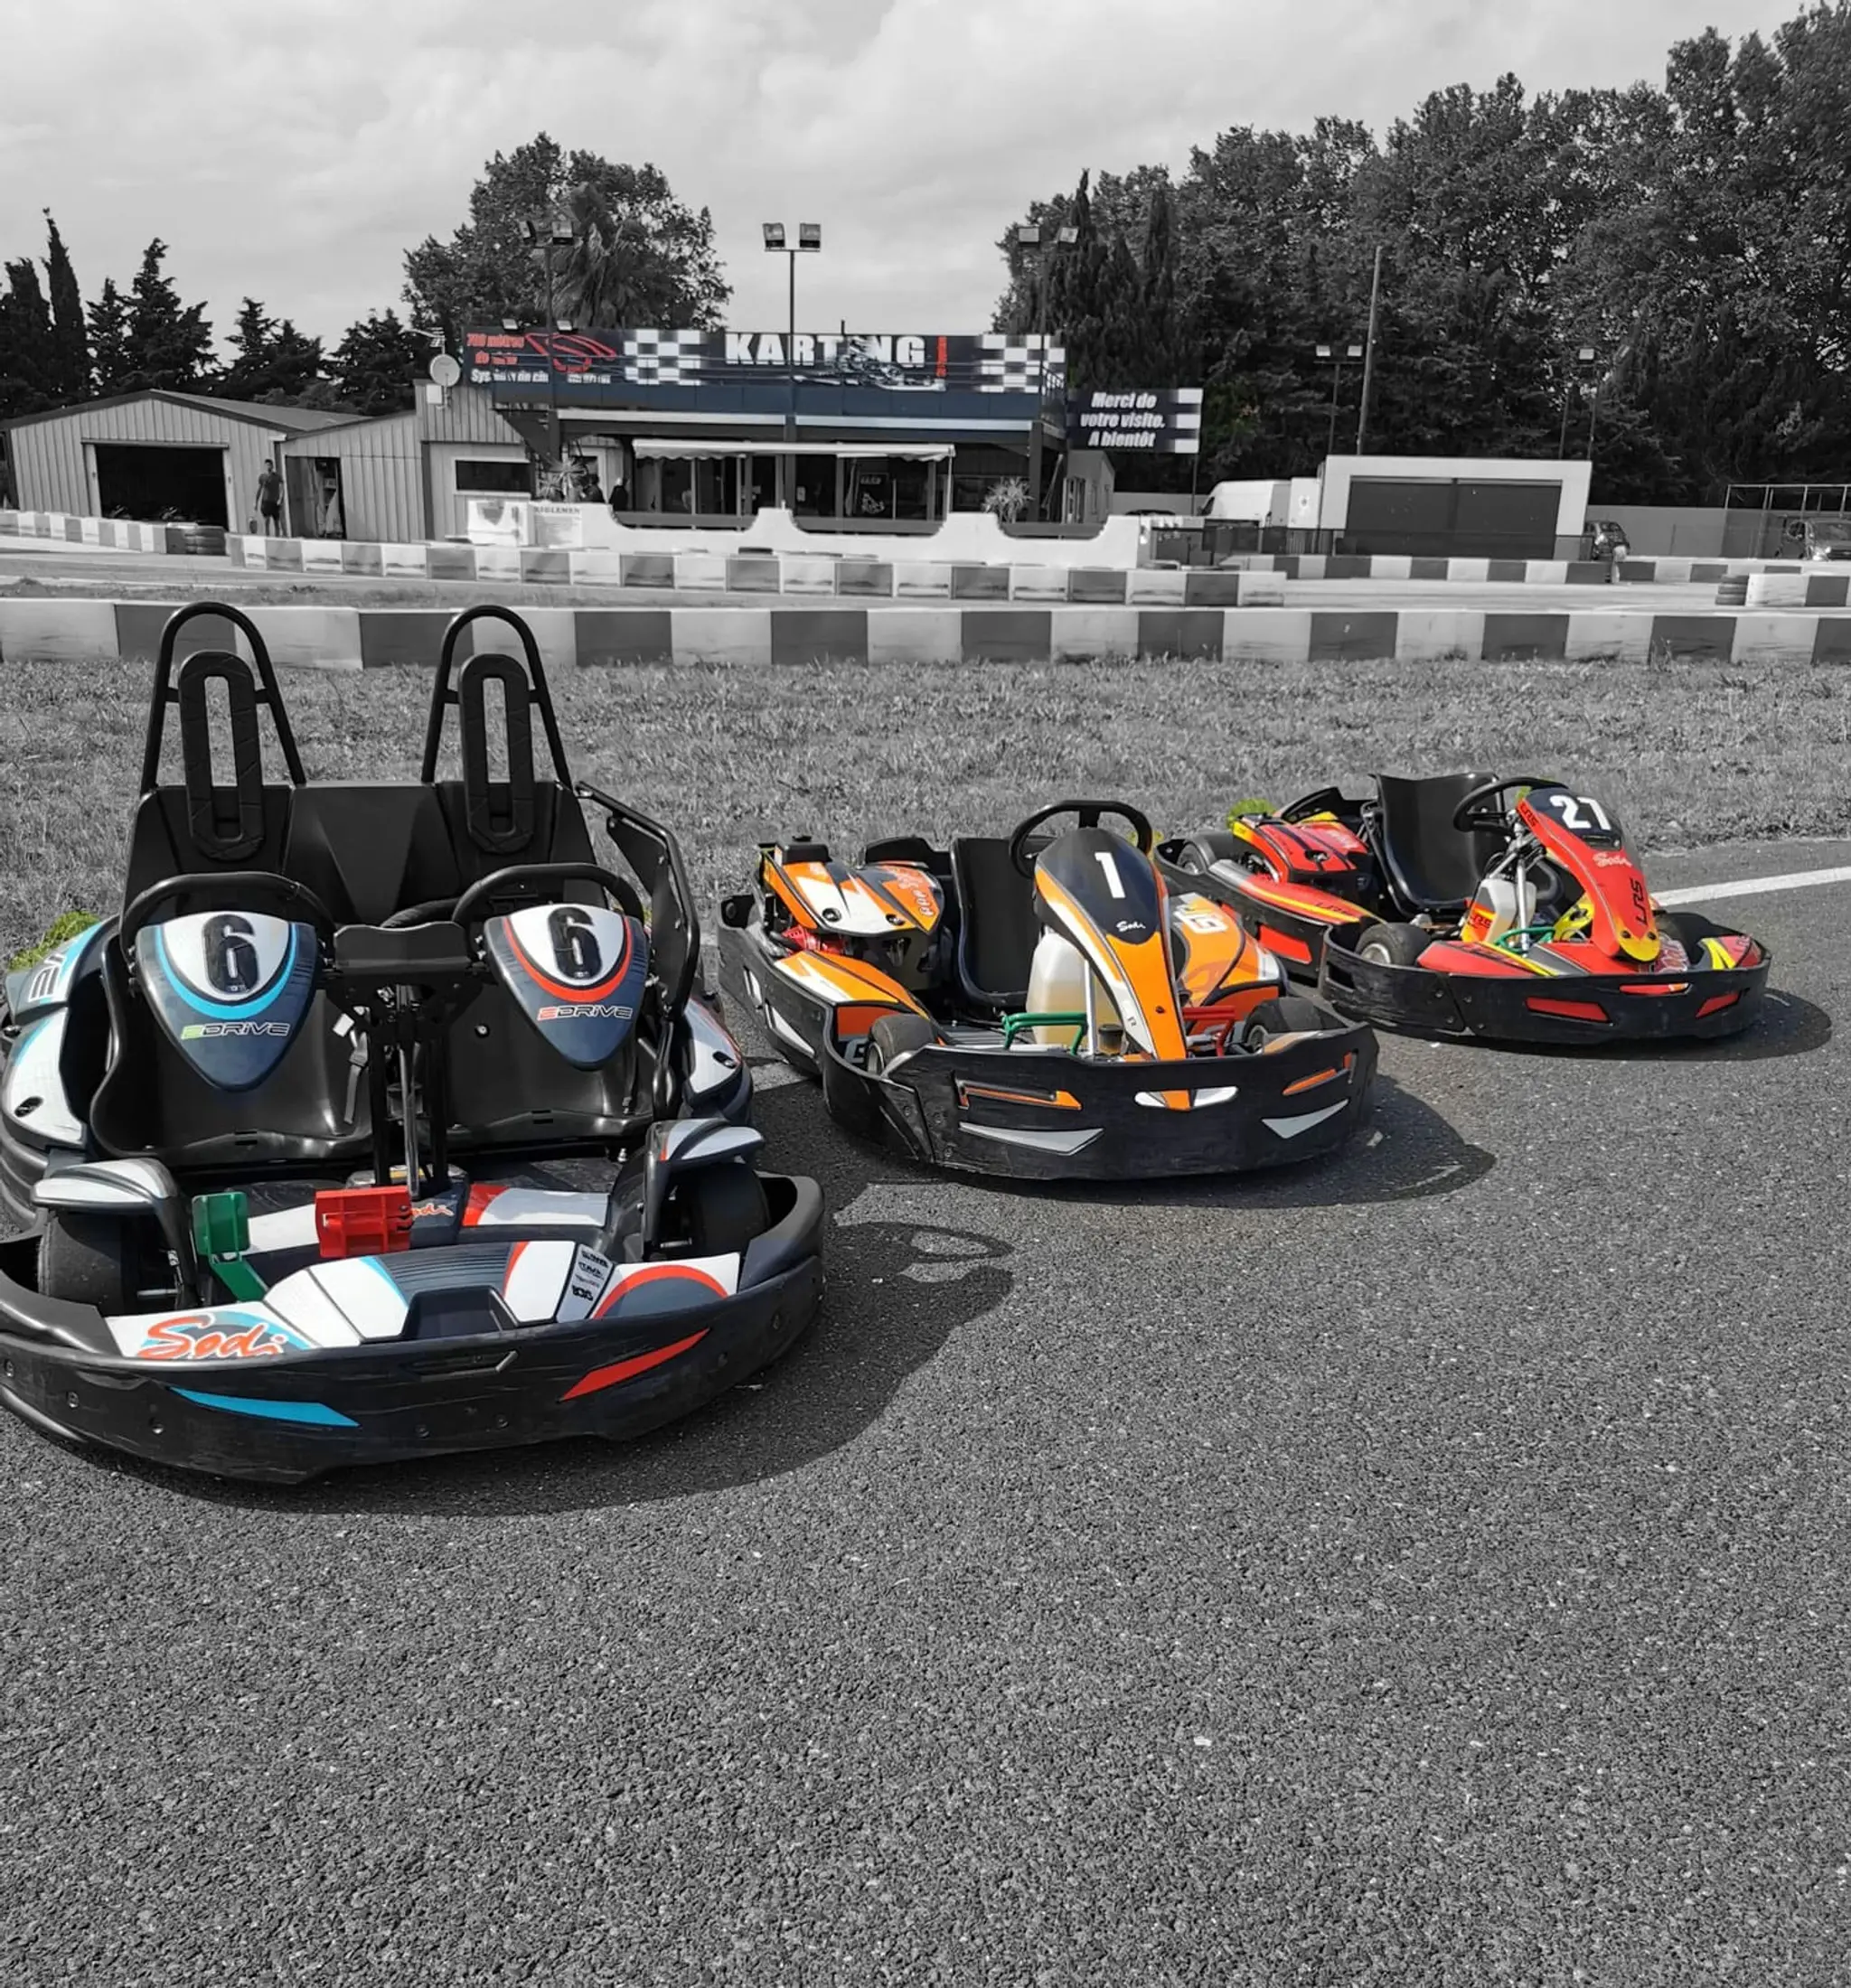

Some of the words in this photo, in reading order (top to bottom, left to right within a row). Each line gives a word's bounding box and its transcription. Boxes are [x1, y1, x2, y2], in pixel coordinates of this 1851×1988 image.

[725, 333, 926, 368] KARTNG
[1091, 391, 1135, 408] Merci
[1135, 391, 1158, 408] de
[1080, 413, 1119, 428] votre
[1121, 412, 1166, 428] visite.
[1087, 430, 1100, 447] A
[1100, 430, 1157, 448] bientôt
[1549, 794, 1611, 830] 27
[1095, 852, 1126, 899] 1
[202, 914, 259, 994] 6
[548, 905, 603, 980] 6
[136, 1312, 289, 1360] Sodi
